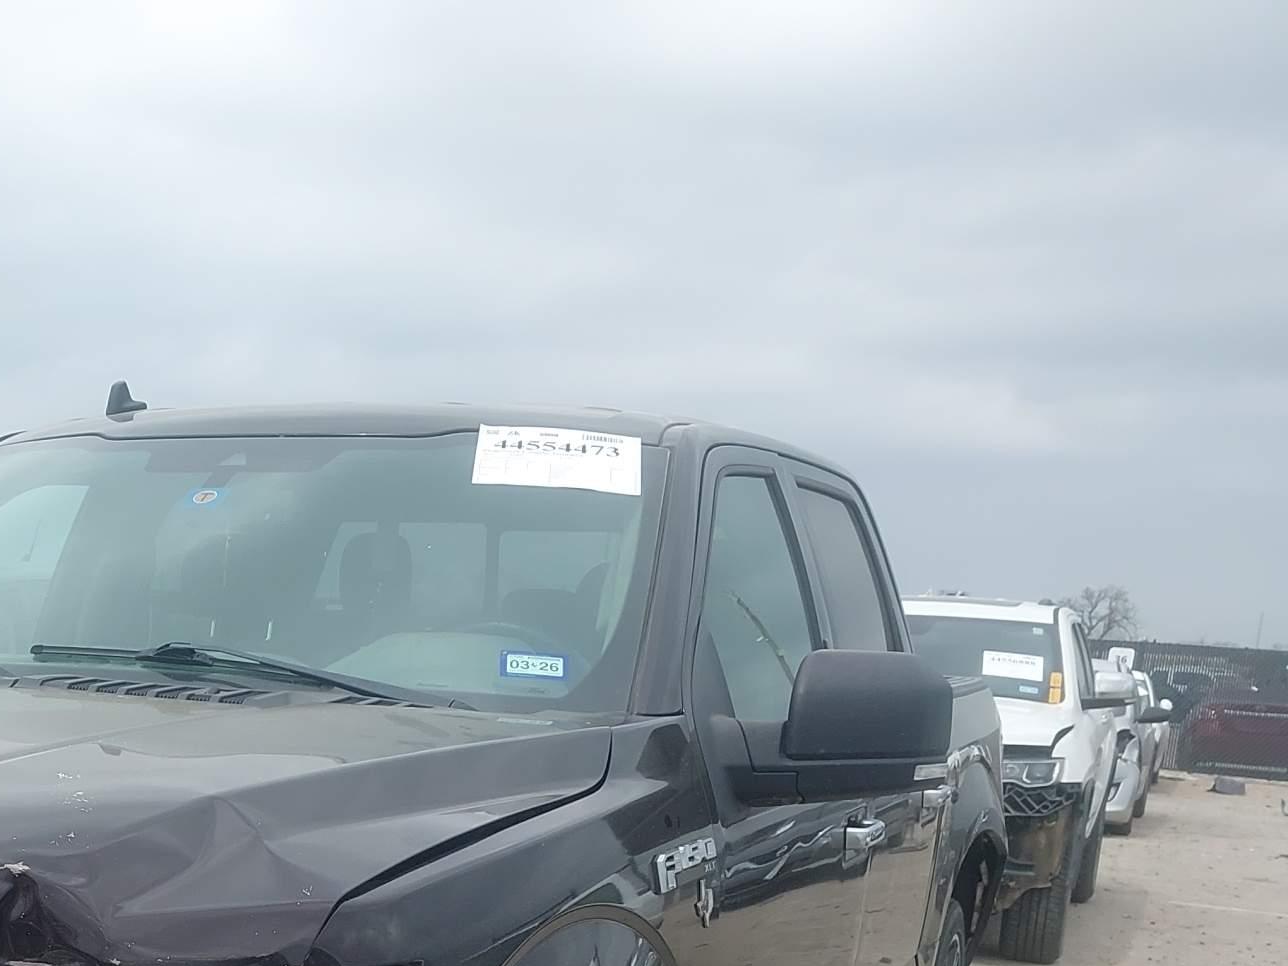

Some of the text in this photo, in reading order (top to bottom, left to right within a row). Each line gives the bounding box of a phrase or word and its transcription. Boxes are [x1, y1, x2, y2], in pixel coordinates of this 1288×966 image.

[493, 439, 621, 458] 44554473
[509, 659, 559, 672] 03 26
